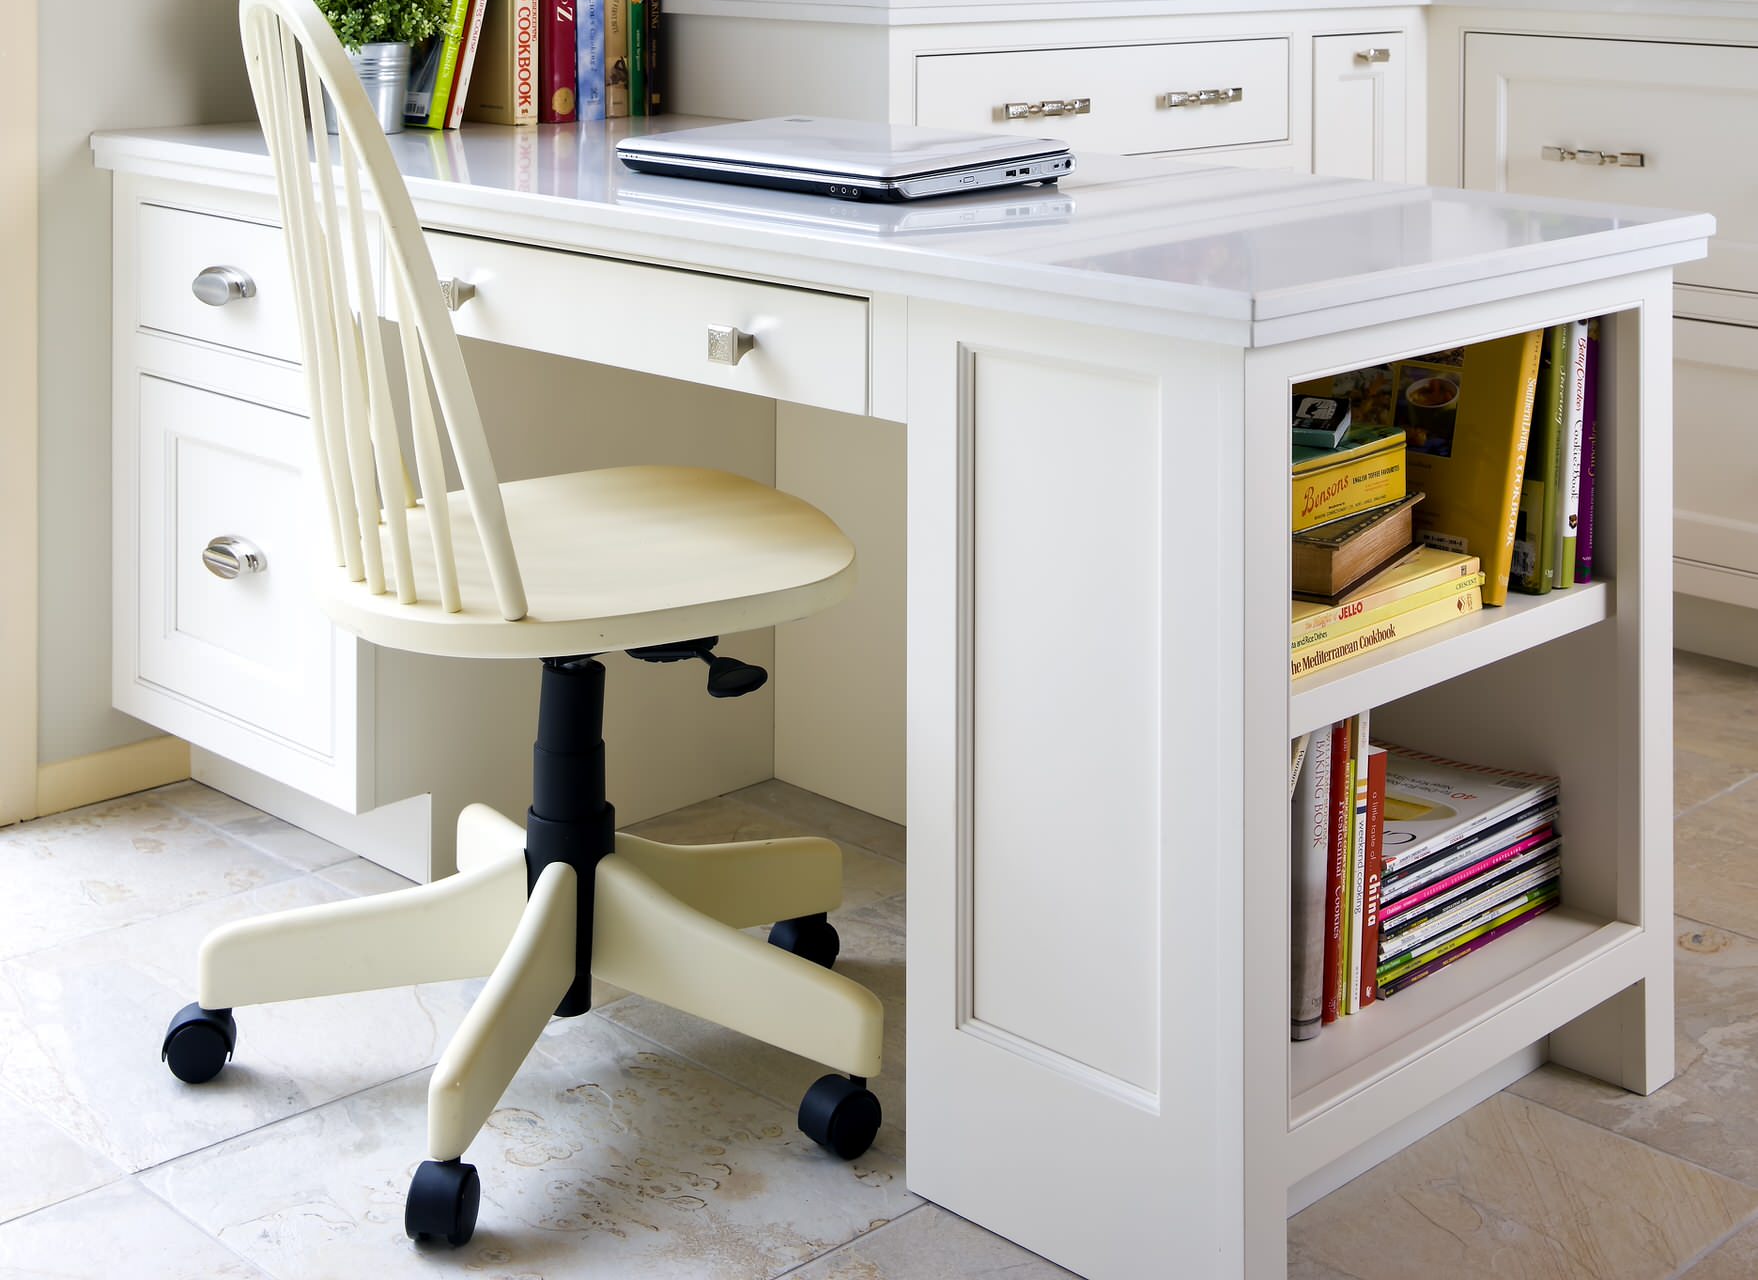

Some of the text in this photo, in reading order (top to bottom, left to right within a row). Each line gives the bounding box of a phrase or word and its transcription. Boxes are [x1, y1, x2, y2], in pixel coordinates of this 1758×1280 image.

[557, 6, 573, 22] Z
[518, 7, 531, 107] COOKBOOK
[1575, 337, 1586, 368] Betty
[1522, 376, 1537, 421] Southern
[1575, 367, 1585, 412] Crocker
[1516, 421, 1530, 452] Living
[1505, 454, 1525, 547] COOKBOOK
[1291, 623, 1397, 676] he Mediterranean Cookbook
[1304, 634, 1315, 645] Rice
[1314, 630, 1328, 642] Dishes
[1313, 740, 1325, 849] BAKING BOOK
[1372, 791, 1377, 799] a
[1333, 801, 1345, 939] Presidential Cookies
[1354, 822, 1365, 915] weekend cooking
[1367, 873, 1381, 927] china
